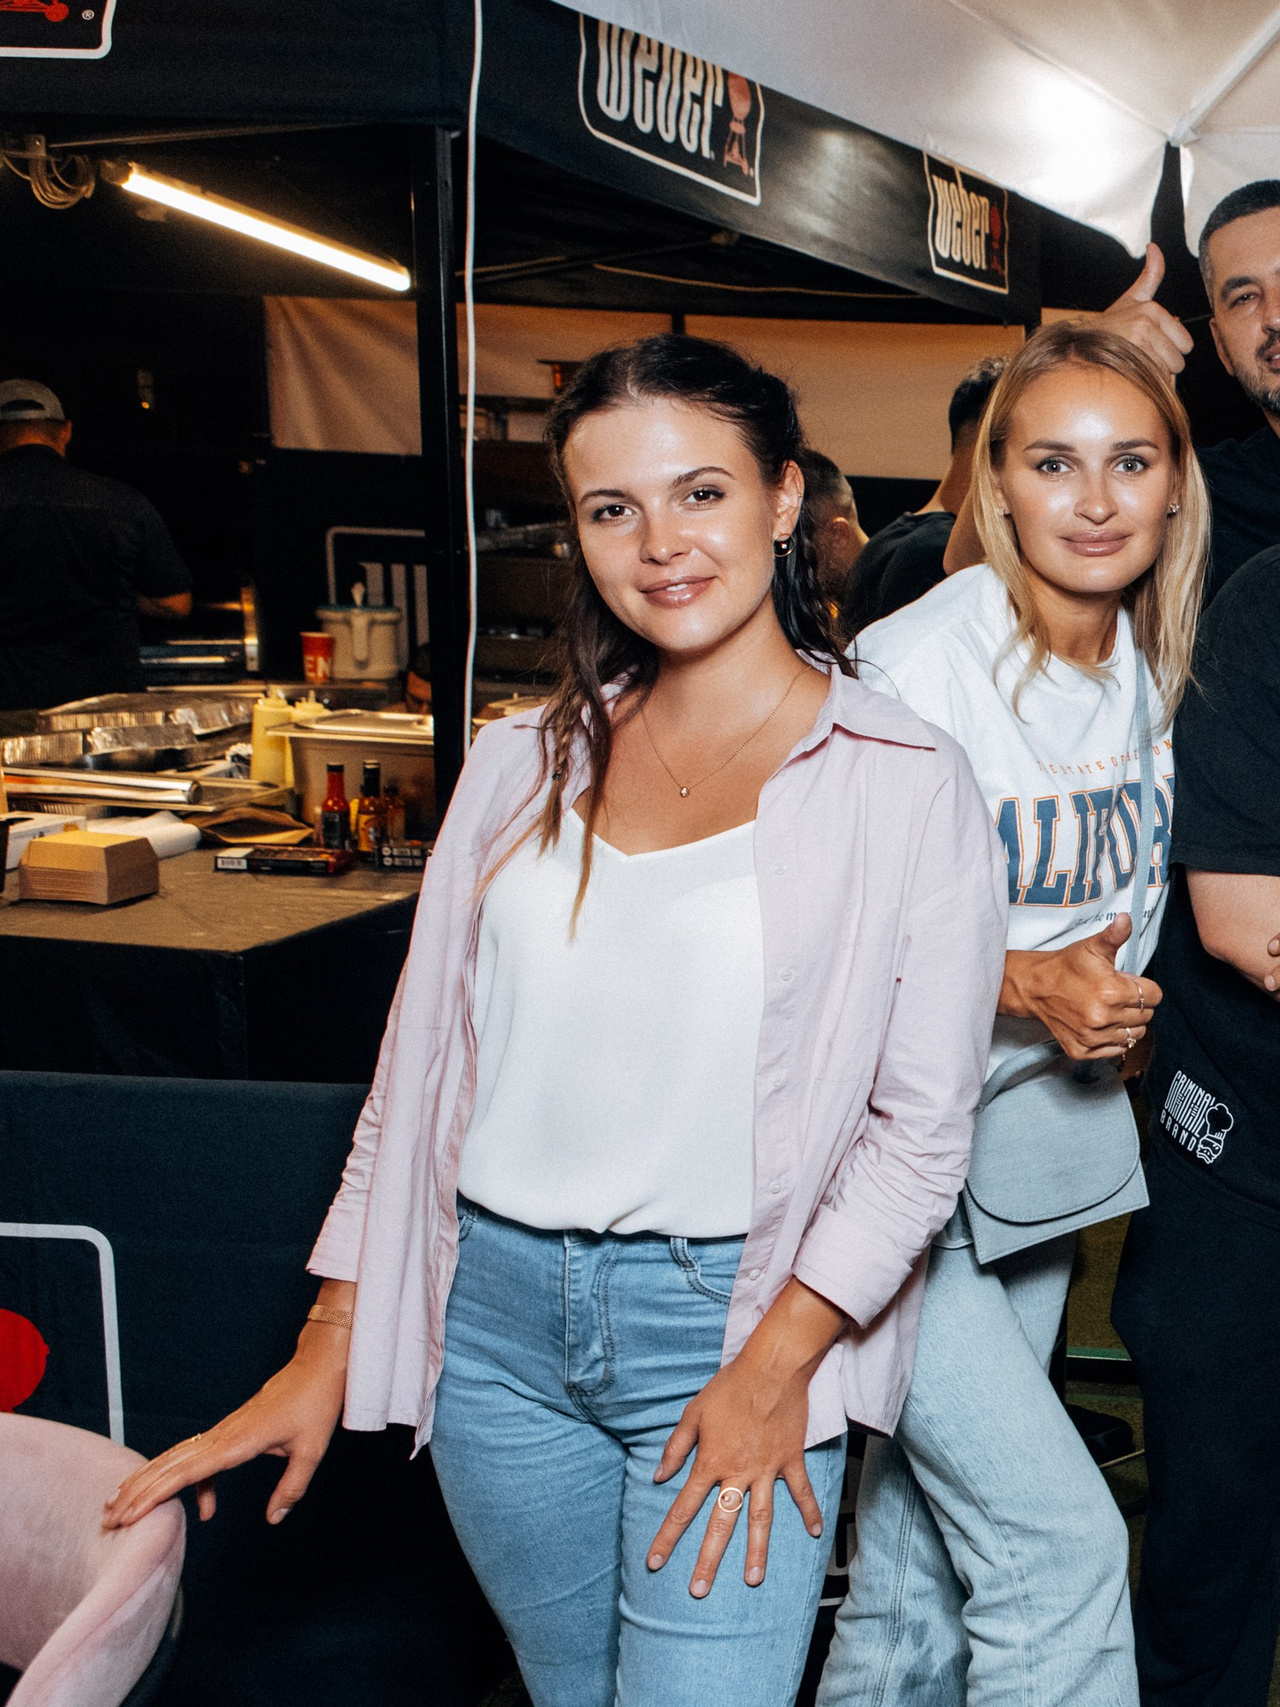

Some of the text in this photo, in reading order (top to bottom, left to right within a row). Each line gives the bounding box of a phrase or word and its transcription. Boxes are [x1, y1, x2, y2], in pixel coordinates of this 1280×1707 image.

[931, 166, 990, 270] weber
[1060, 761, 1106, 775] STATE
[1111, 755, 1125, 767] OF
[995, 774, 1174, 908] ALIFOR
[1160, 1109, 1197, 1151] BRAND
[1164, 1070, 1216, 1138] CRIMINAL
